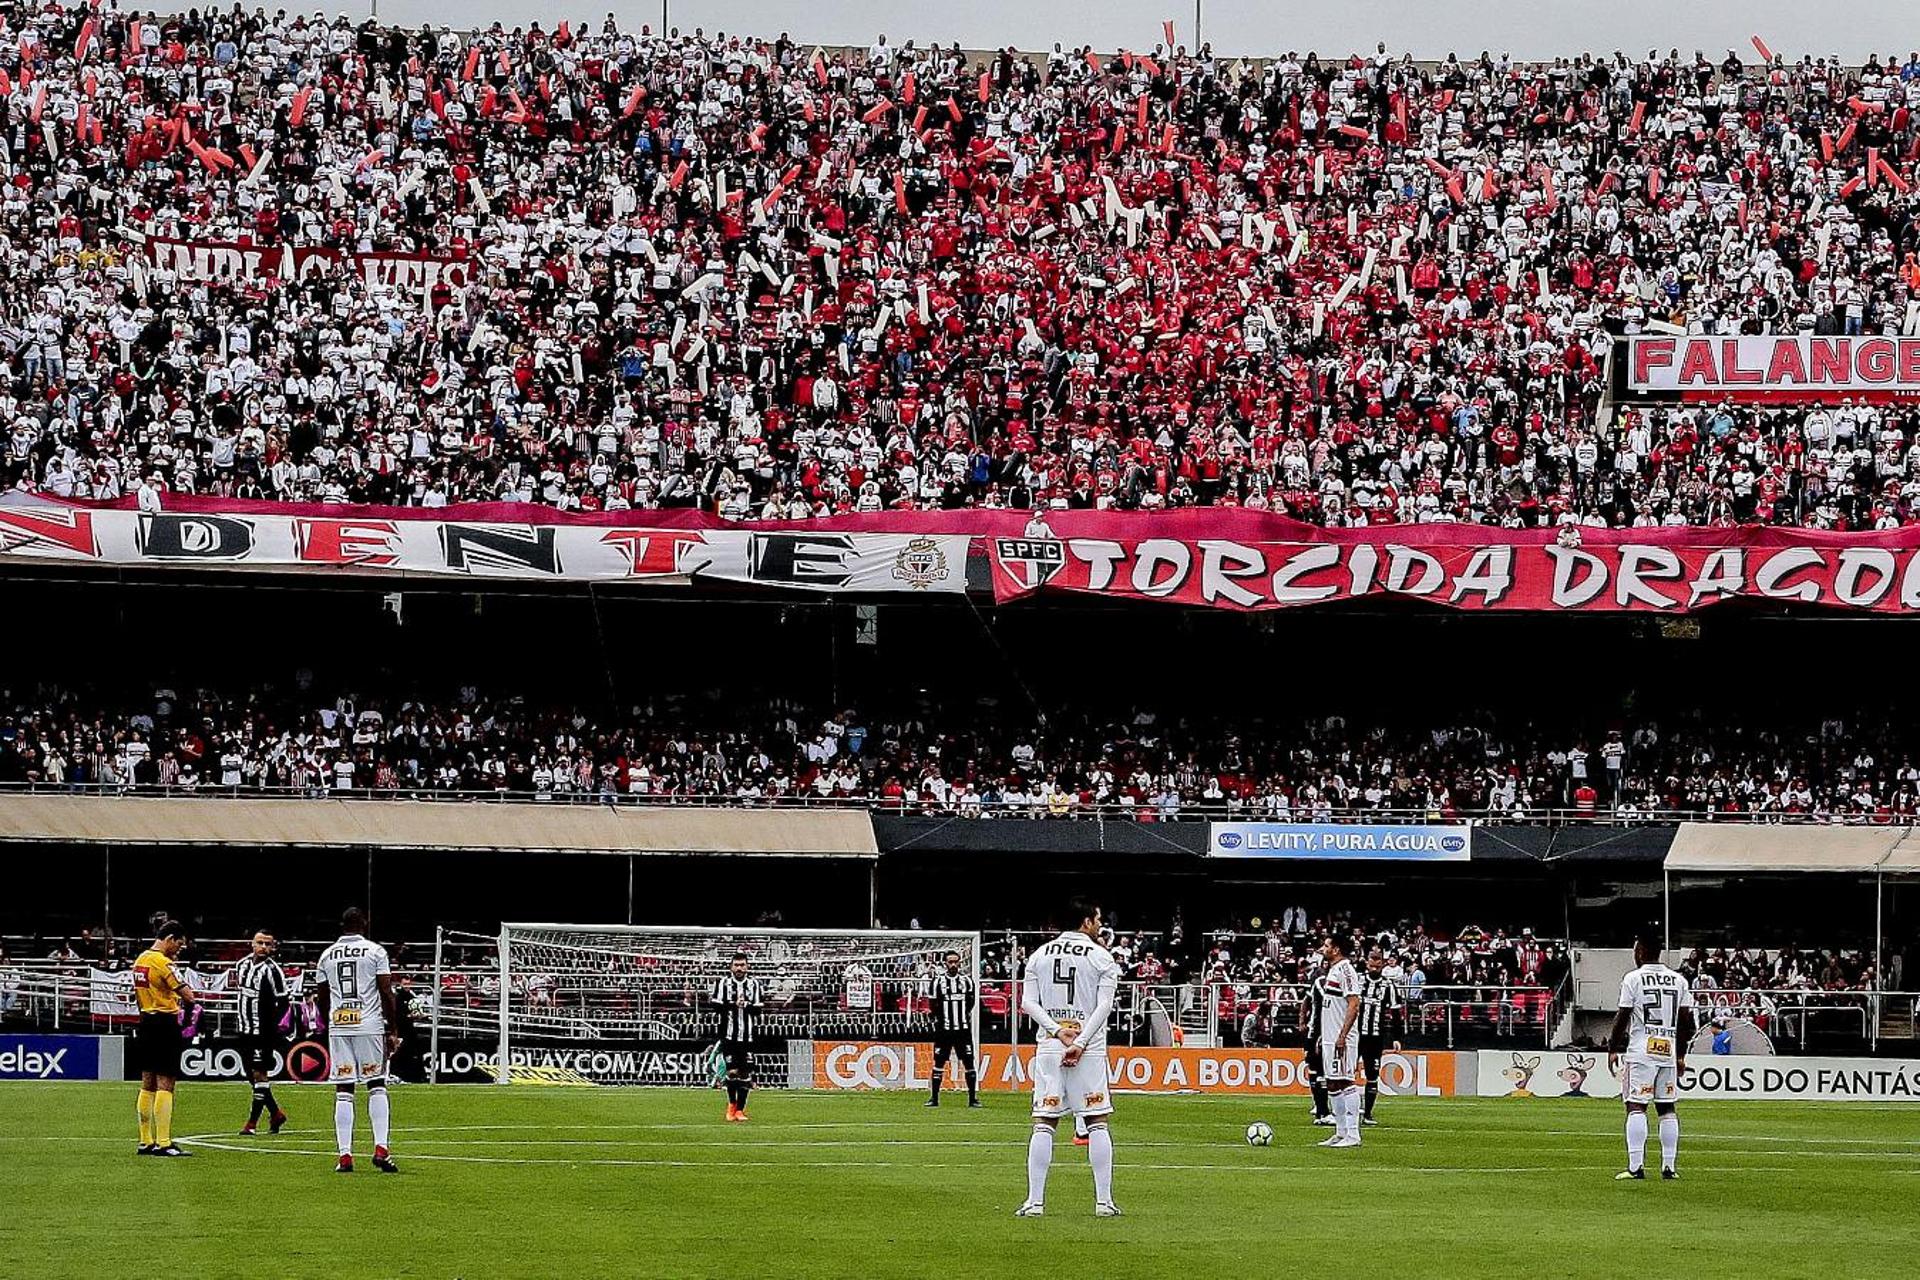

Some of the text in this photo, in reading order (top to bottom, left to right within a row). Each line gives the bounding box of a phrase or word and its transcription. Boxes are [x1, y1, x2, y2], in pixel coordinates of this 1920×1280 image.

[1002, 542, 1060, 559] SPFC
[1068, 538, 1512, 607] TORCIDA
[1247, 833, 1317, 851] LEVITY,
[1323, 834, 1377, 850] PURA
[1380, 831, 1436, 851] ÁGUA
[329, 945, 369, 960] inter
[1044, 943, 1094, 957] inter
[1052, 958, 1077, 1005] 4
[1642, 973, 1676, 986] inter
[1643, 989, 1678, 1027] 27
[826, 1046, 932, 1089] GOL
[1162, 1058, 1189, 1085] A
[1676, 1067, 1755, 1092] GOLS
[1763, 1069, 1810, 1093] DO
